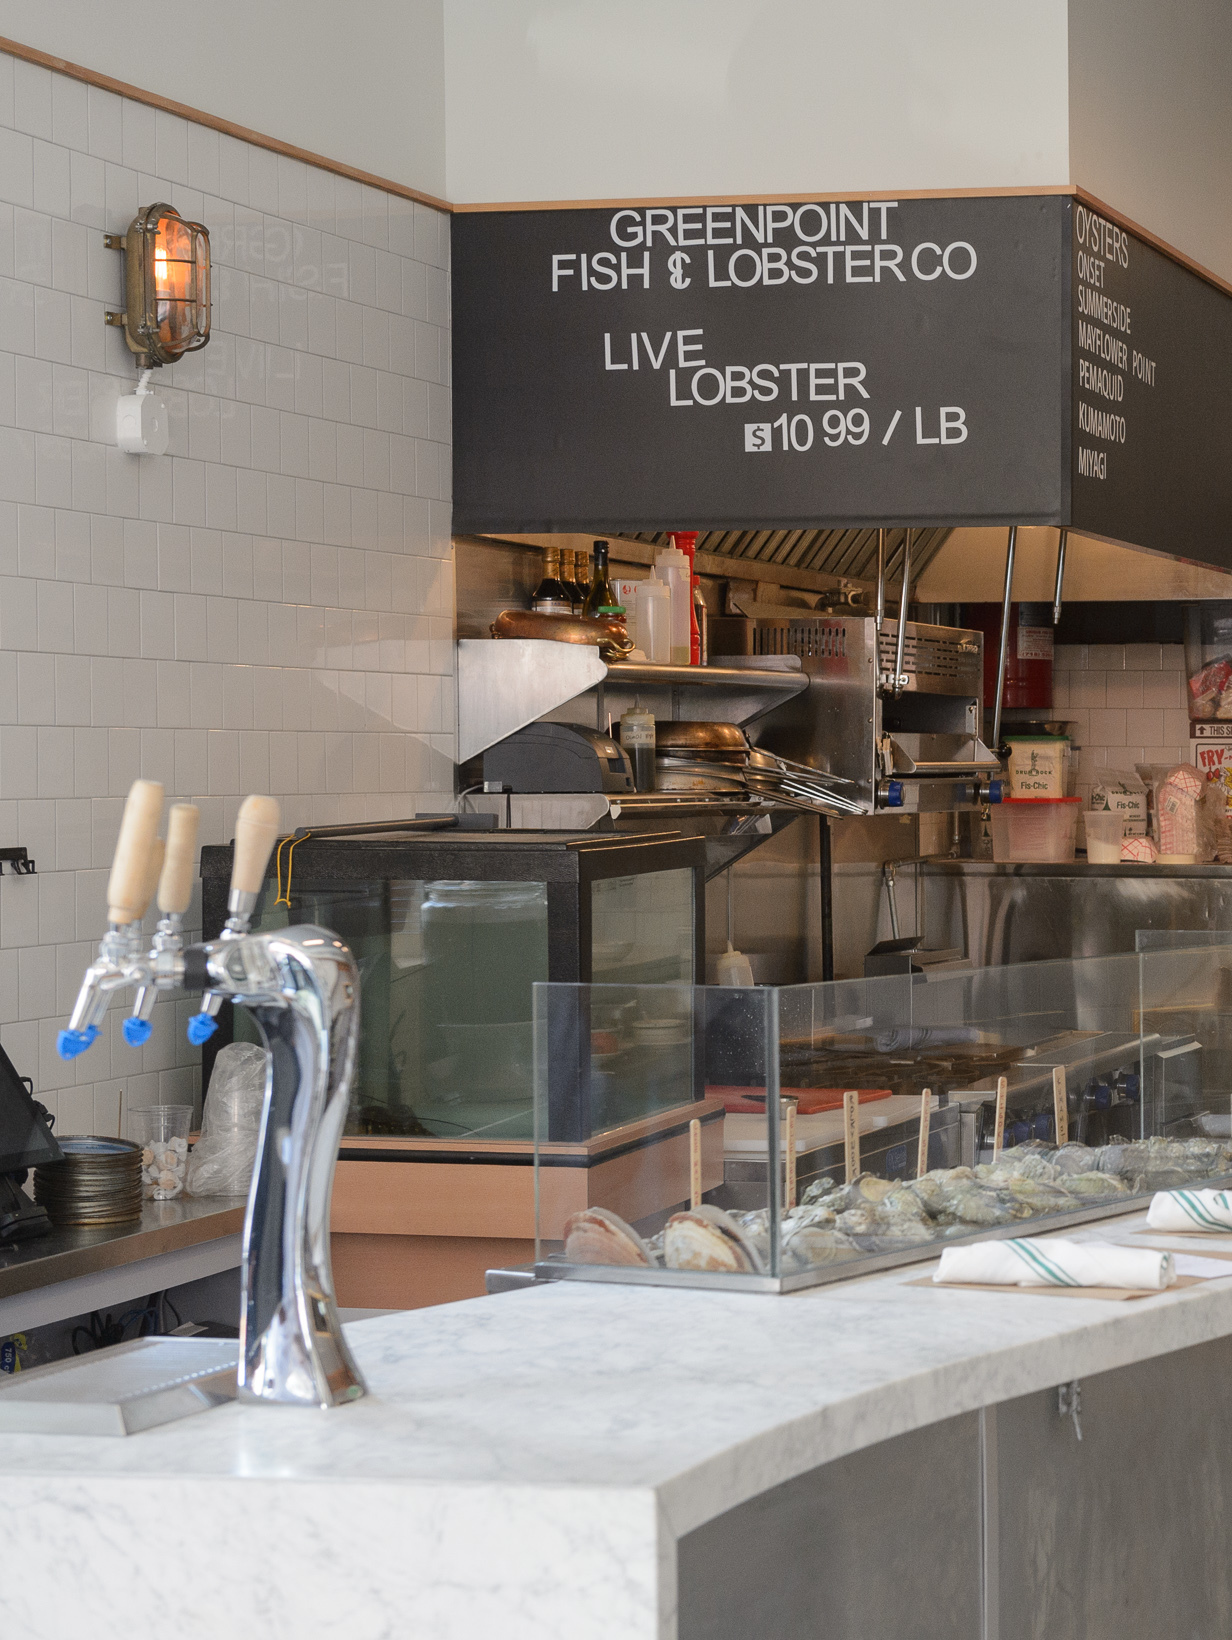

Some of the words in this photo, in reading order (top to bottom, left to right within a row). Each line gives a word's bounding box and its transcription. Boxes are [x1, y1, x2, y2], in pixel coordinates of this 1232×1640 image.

[610, 201, 898, 247] GREENPOINT
[1076, 205, 1129, 269] OYSTERS
[552, 251, 650, 292] FISH
[707, 244, 907, 288] LOBSTER
[911, 241, 977, 281] CO
[1077, 250, 1105, 289] ONSET
[1078, 284, 1131, 335] SUMMERSIDE
[604, 328, 706, 371] LIVE
[1078, 319, 1128, 372] MAYFLOWER
[1132, 350, 1157, 387] POINT
[669, 361, 871, 407] LOBSTER
[1079, 358, 1124, 402] PEMAQUID
[915, 406, 968, 445] LB
[1078, 400, 1126, 444] KUMAMOTO
[1078, 446, 1107, 480] MIYAGI
[1209, 725, 1225, 736] THIS
[1199, 748, 1225, 768] FRY
